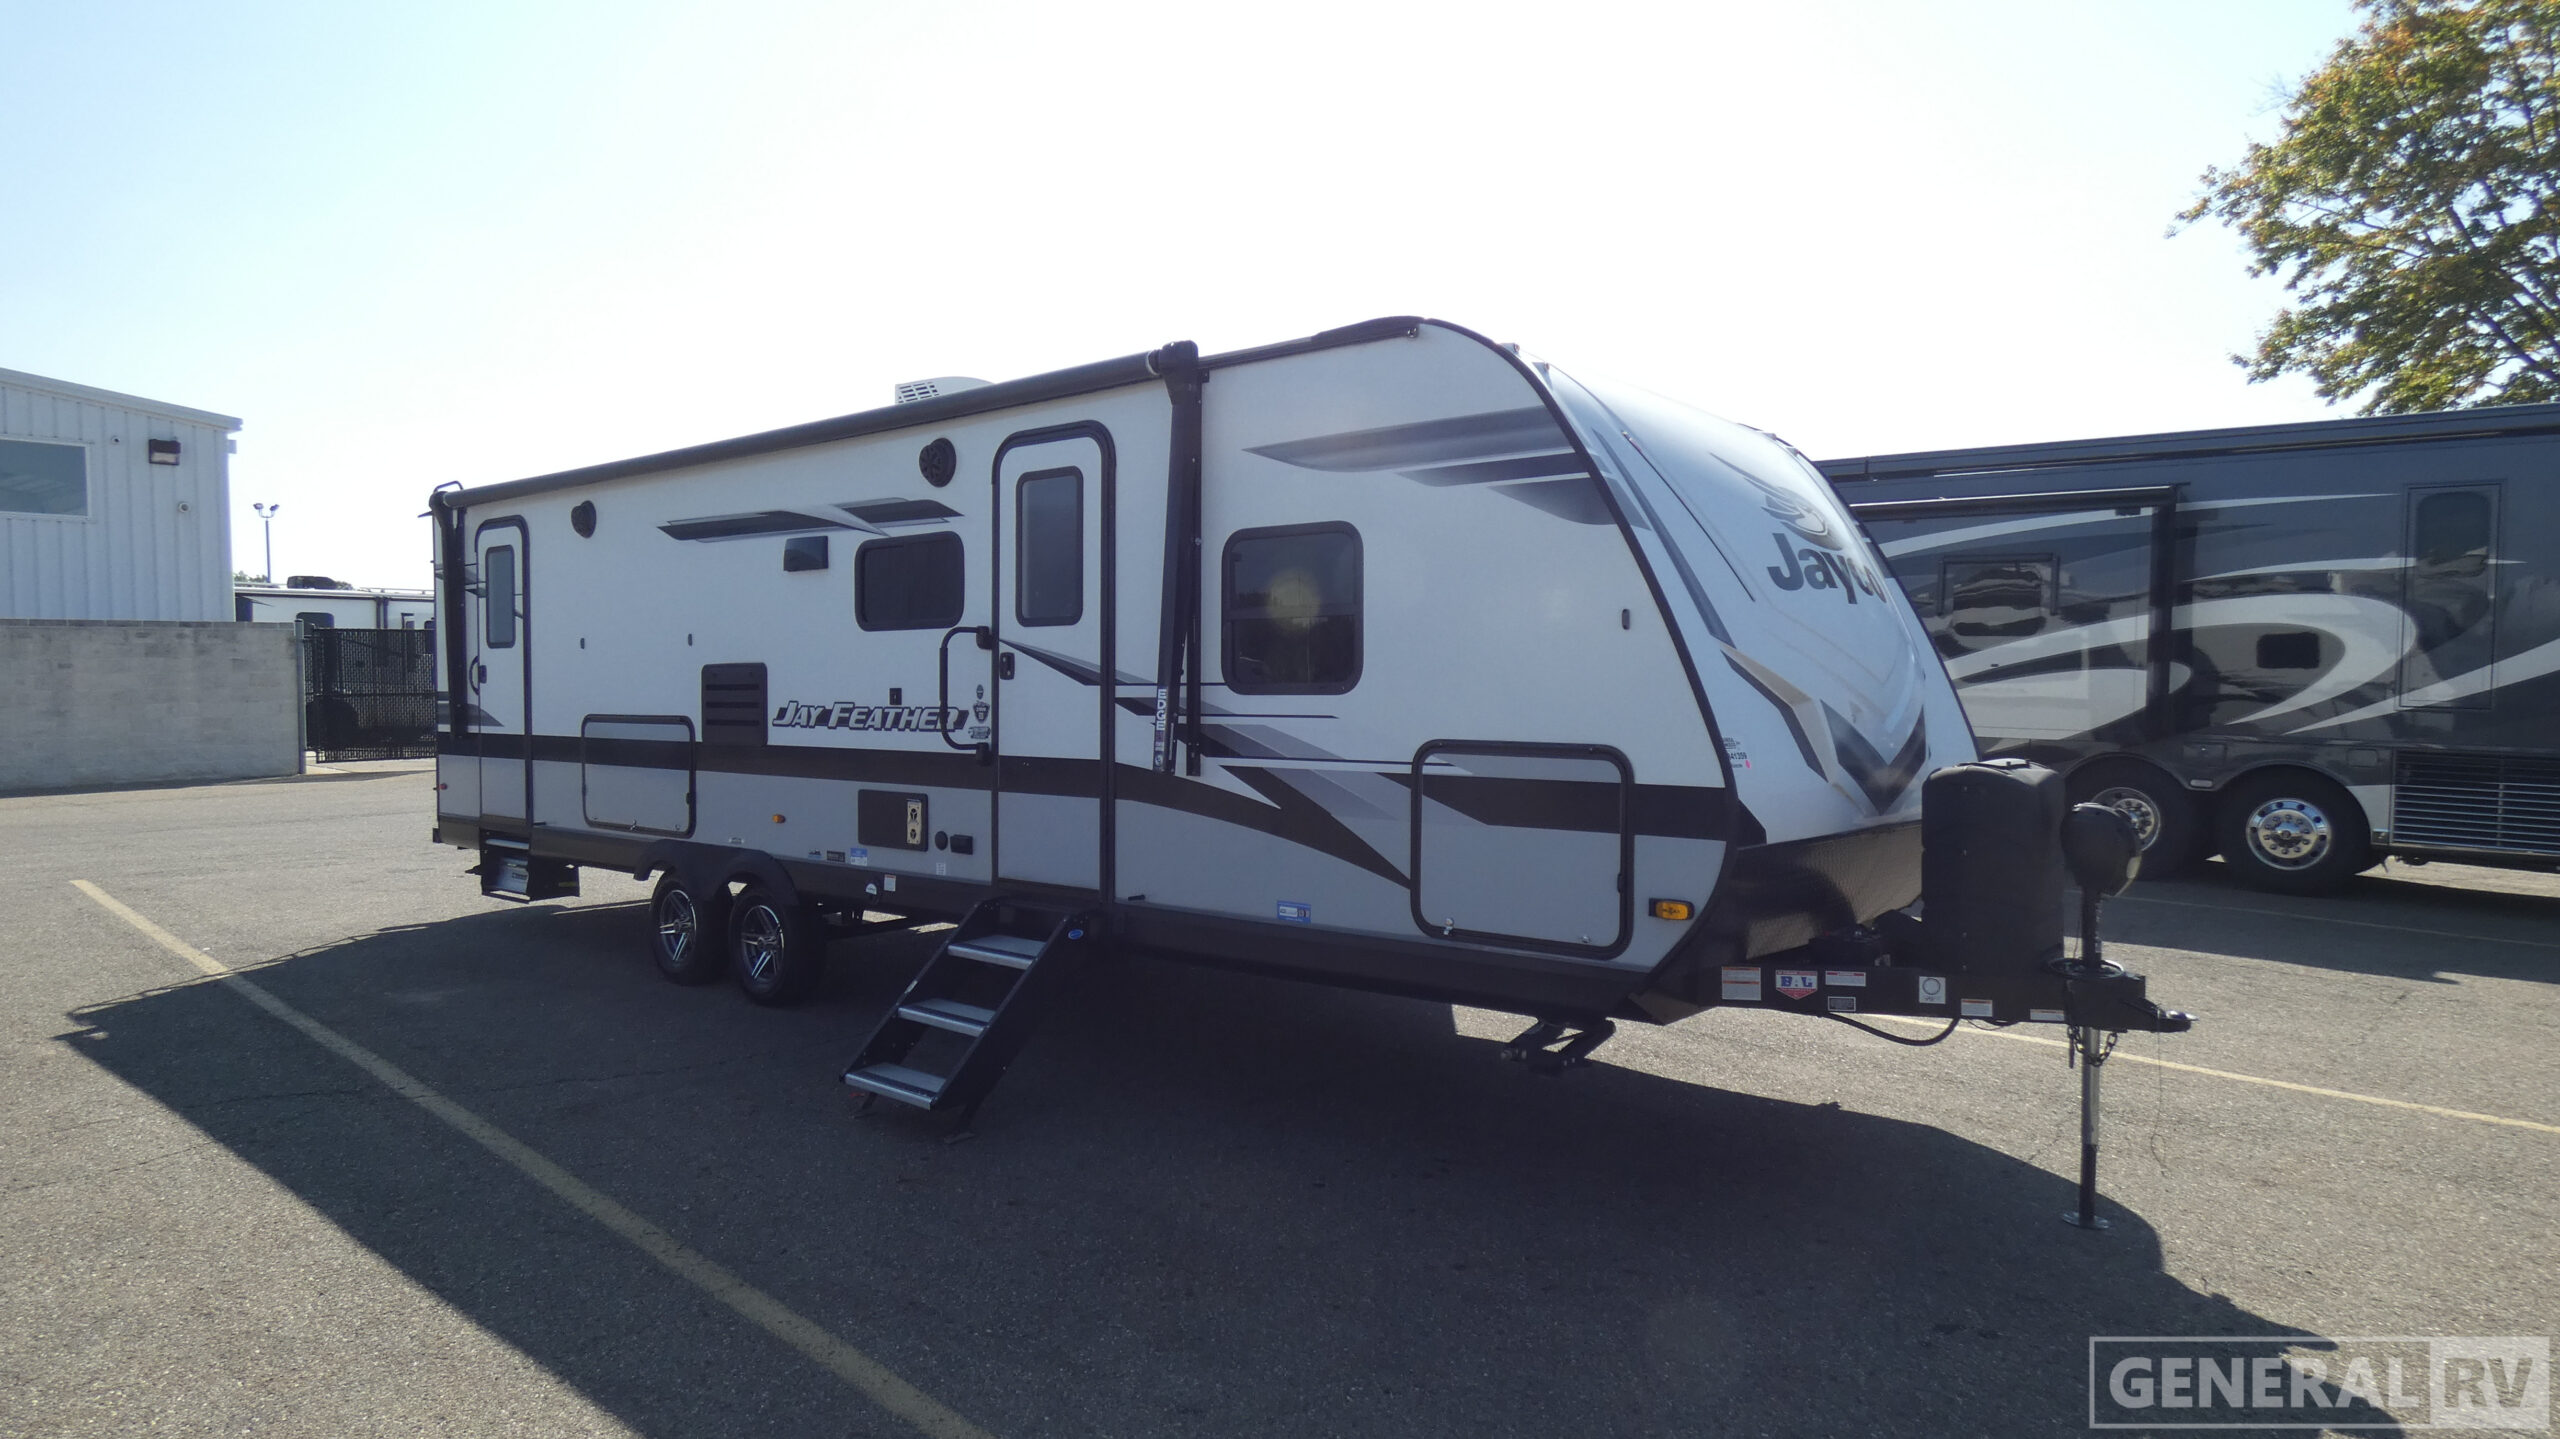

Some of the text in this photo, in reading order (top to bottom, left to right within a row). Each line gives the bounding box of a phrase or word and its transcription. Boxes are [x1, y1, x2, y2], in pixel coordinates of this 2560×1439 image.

[772, 700, 825, 728] JAY
[827, 701, 961, 732] FEATHER
[1156, 688, 1167, 731] EDGE
